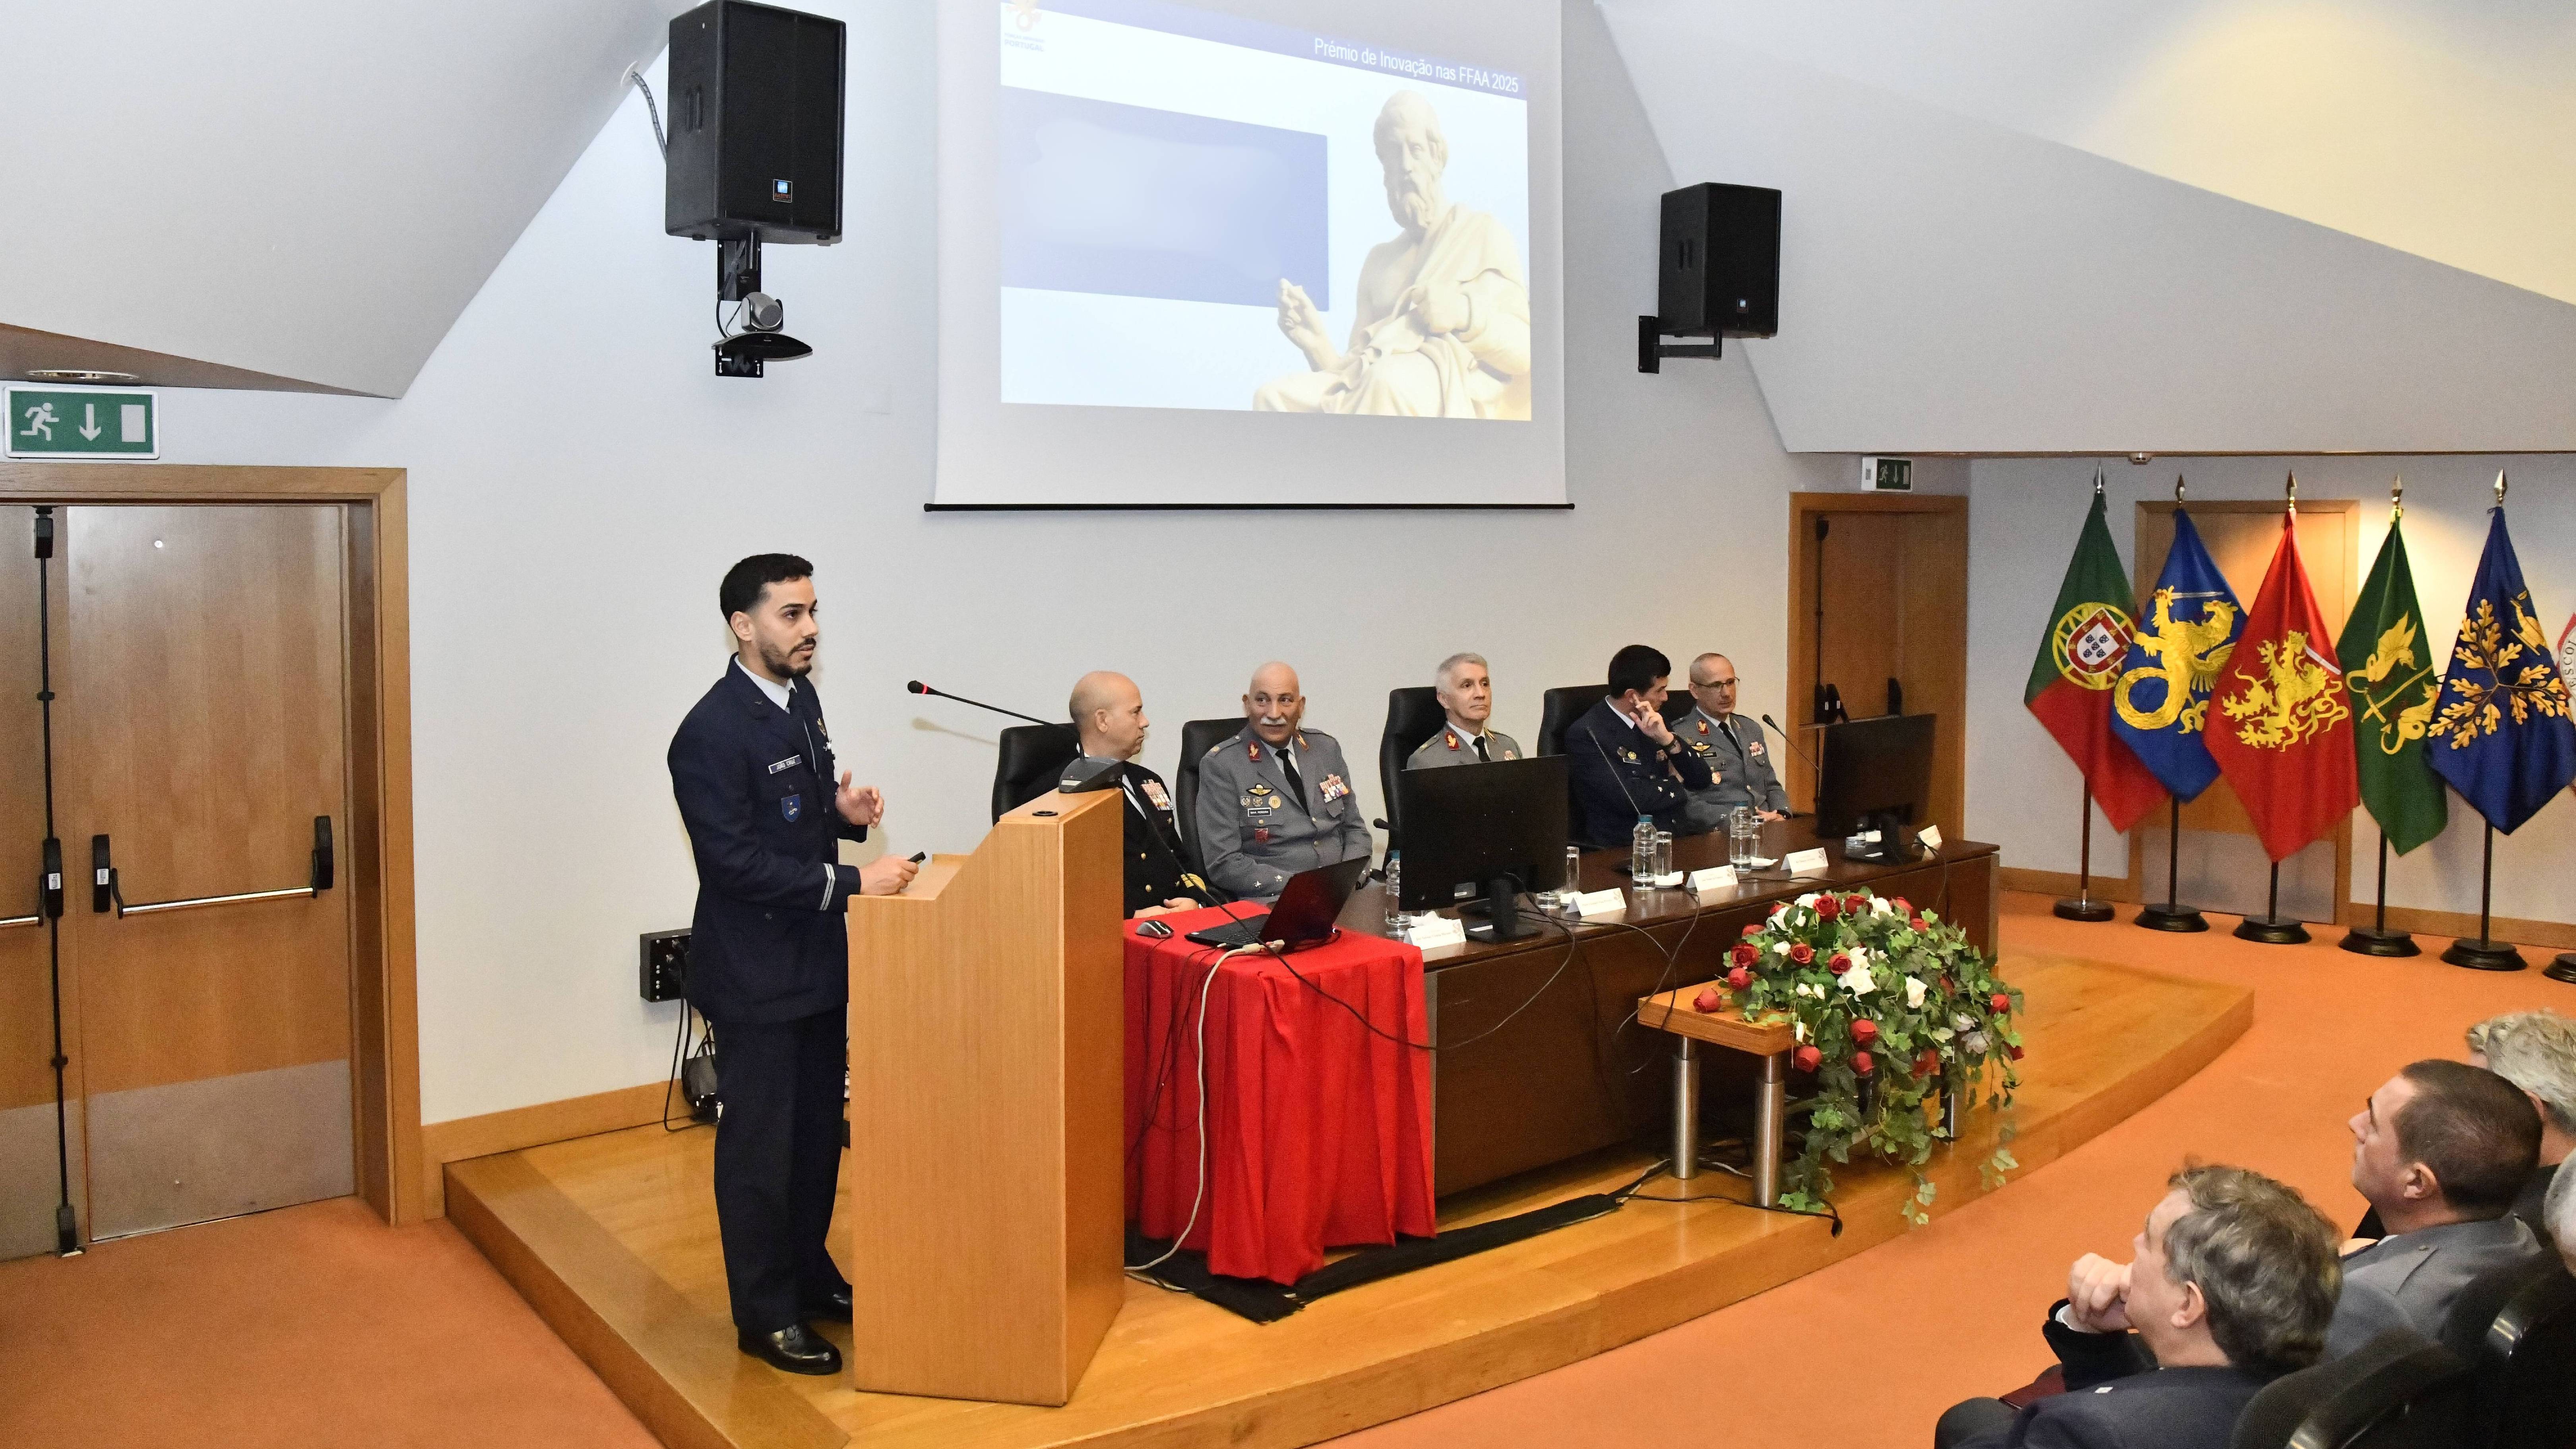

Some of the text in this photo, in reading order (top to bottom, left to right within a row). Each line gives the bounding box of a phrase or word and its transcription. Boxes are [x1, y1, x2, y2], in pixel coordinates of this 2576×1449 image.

[1004, 39, 1044, 52] PORTUGAL
[1314, 37, 1518, 93] Prémio de Inovação nas FFAA 2025
